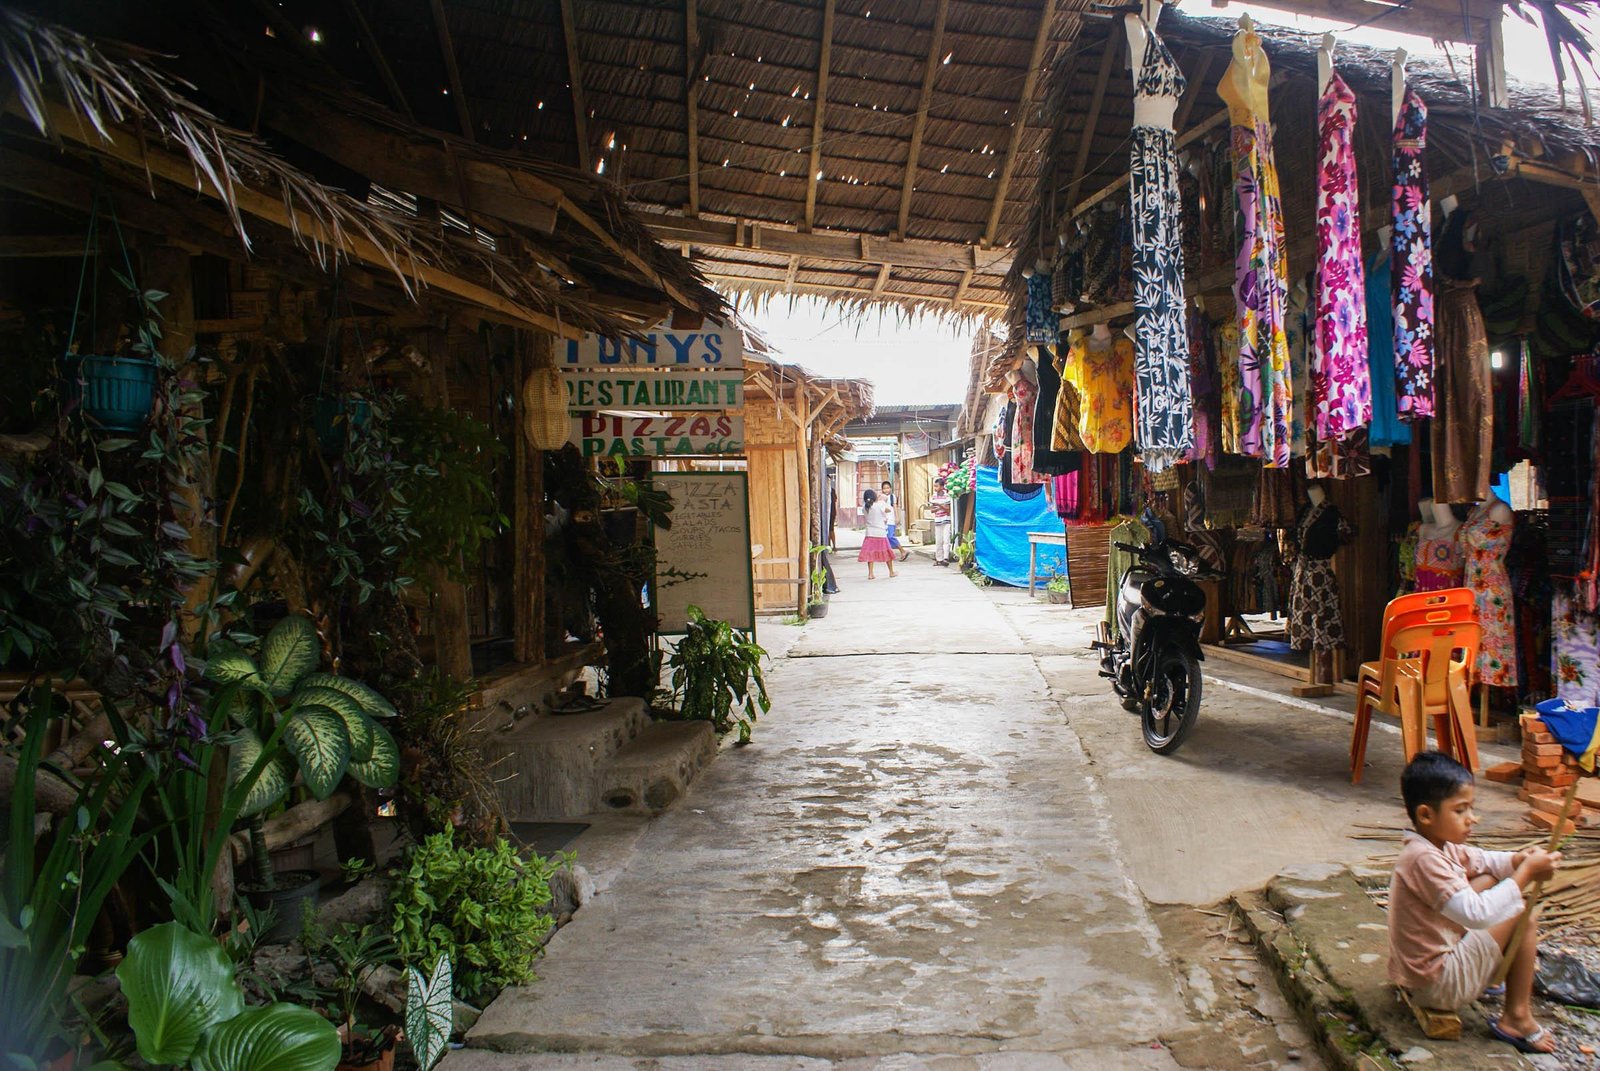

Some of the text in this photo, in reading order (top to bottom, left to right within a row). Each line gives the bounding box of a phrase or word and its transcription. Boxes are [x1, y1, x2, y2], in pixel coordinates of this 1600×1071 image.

[566, 333, 723, 364] TONY'S
[582, 436, 695, 457] PASTA
[668, 480, 740, 498] PIZZA
